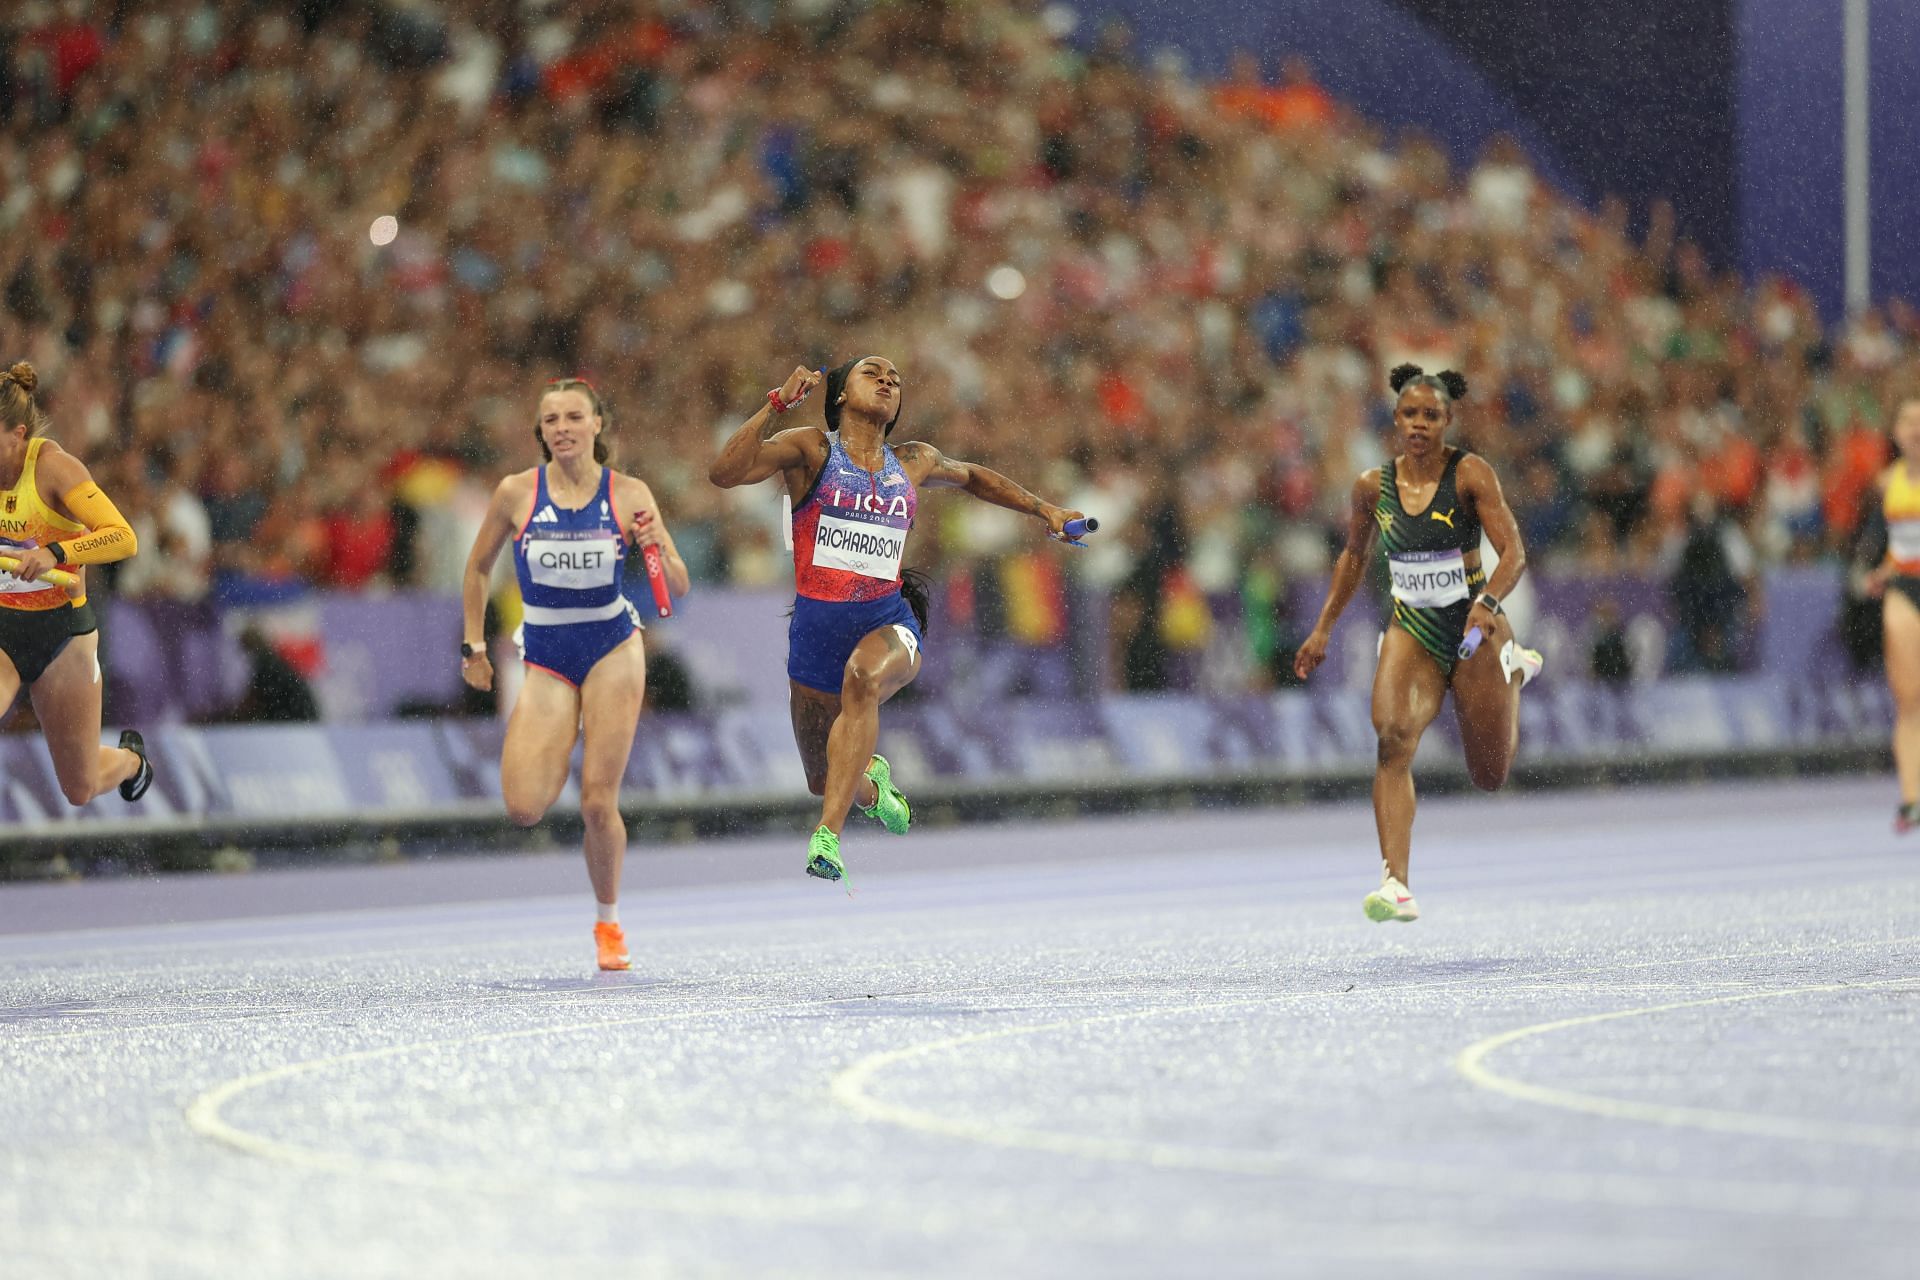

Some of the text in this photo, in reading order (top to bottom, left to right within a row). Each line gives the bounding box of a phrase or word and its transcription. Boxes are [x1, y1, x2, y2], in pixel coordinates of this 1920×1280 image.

[845, 511, 868, 520] PARIS
[73, 531, 124, 553] GERMANY
[817, 525, 902, 561] RICHARDSON
[540, 551, 604, 570] GALET
[1394, 567, 1464, 591] CLAYTON
